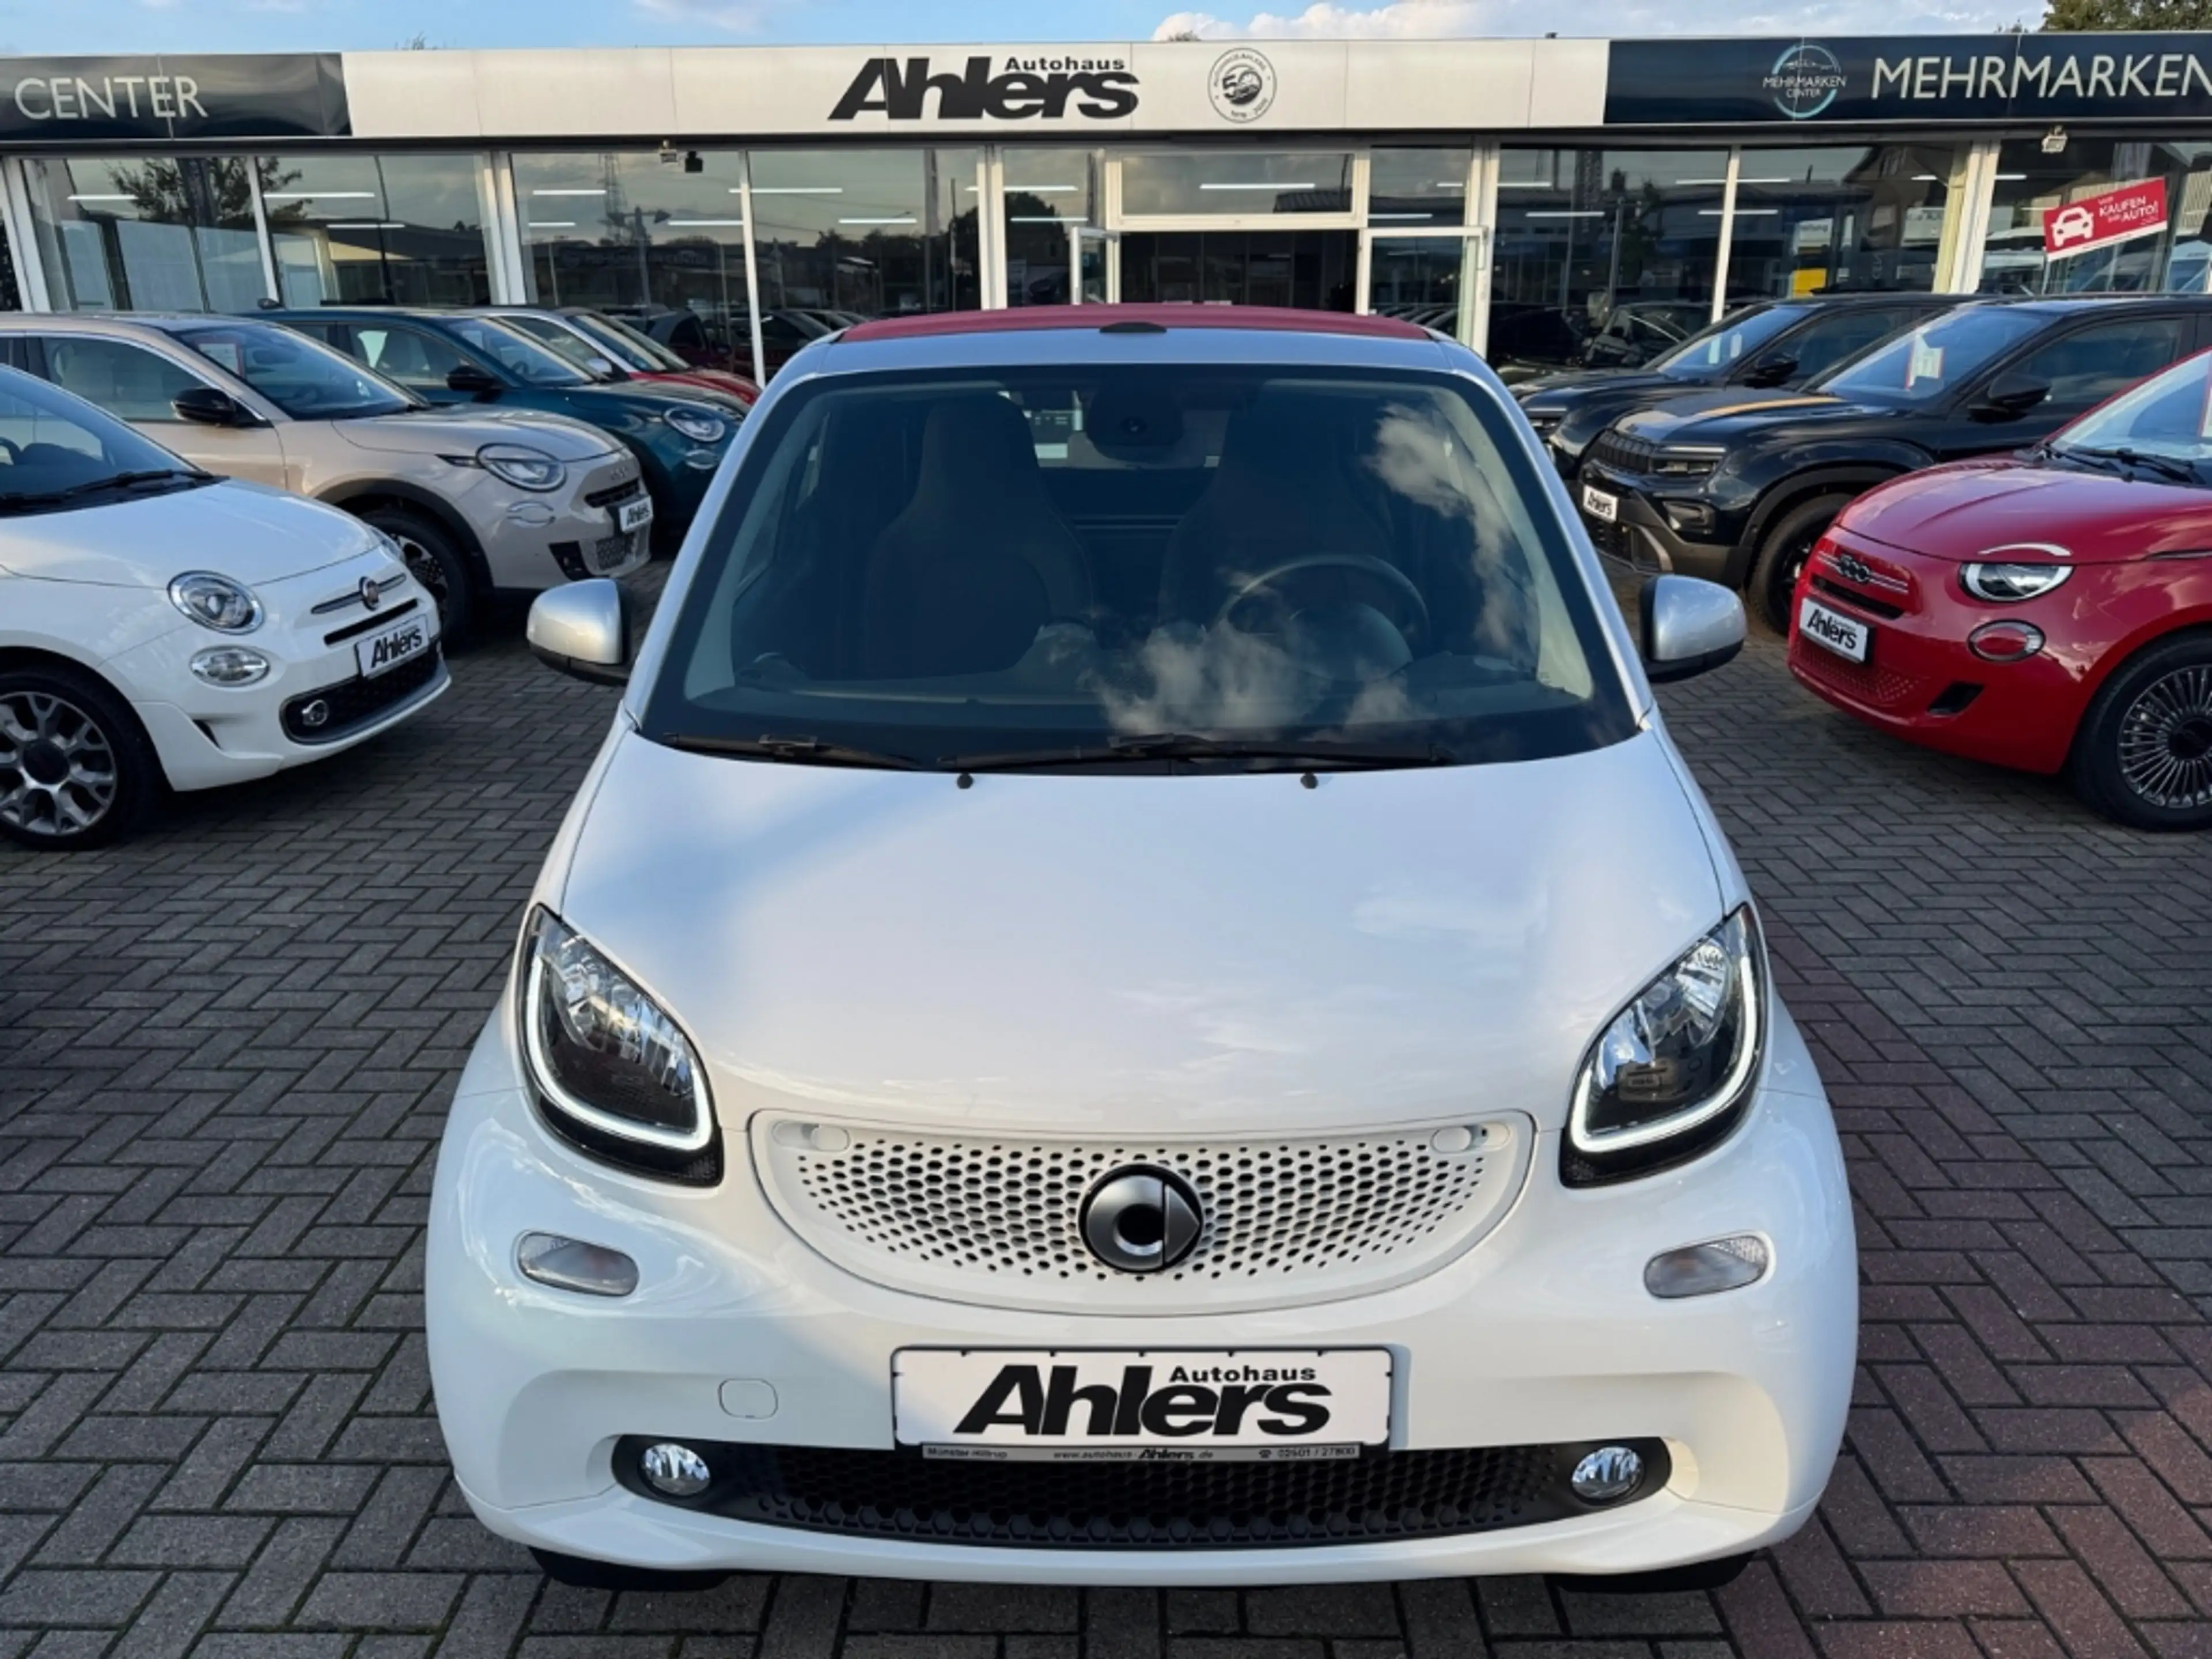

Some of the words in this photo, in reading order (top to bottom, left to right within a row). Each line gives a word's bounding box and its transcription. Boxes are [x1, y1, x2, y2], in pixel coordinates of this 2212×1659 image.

[1005, 56, 1126, 71] Autohaus
[1872, 54, 2212, 99] MEHRMARKEN
[828, 56, 1139, 120] Ahlers
[1762, 75, 1847, 88] MEHRMARKEN
[1786, 88, 1821, 98] CENTER
[14, 76, 209, 119] CENTER
[2099, 195, 2146, 217] KAUFEN
[2121, 200, 2159, 222] AUTO!
[1807, 609, 1858, 650] Ahlers
[371, 628, 422, 668] Ahlers
[1169, 1365, 1317, 1382] Autohaus
[953, 1364, 1333, 1435] Ahlers
